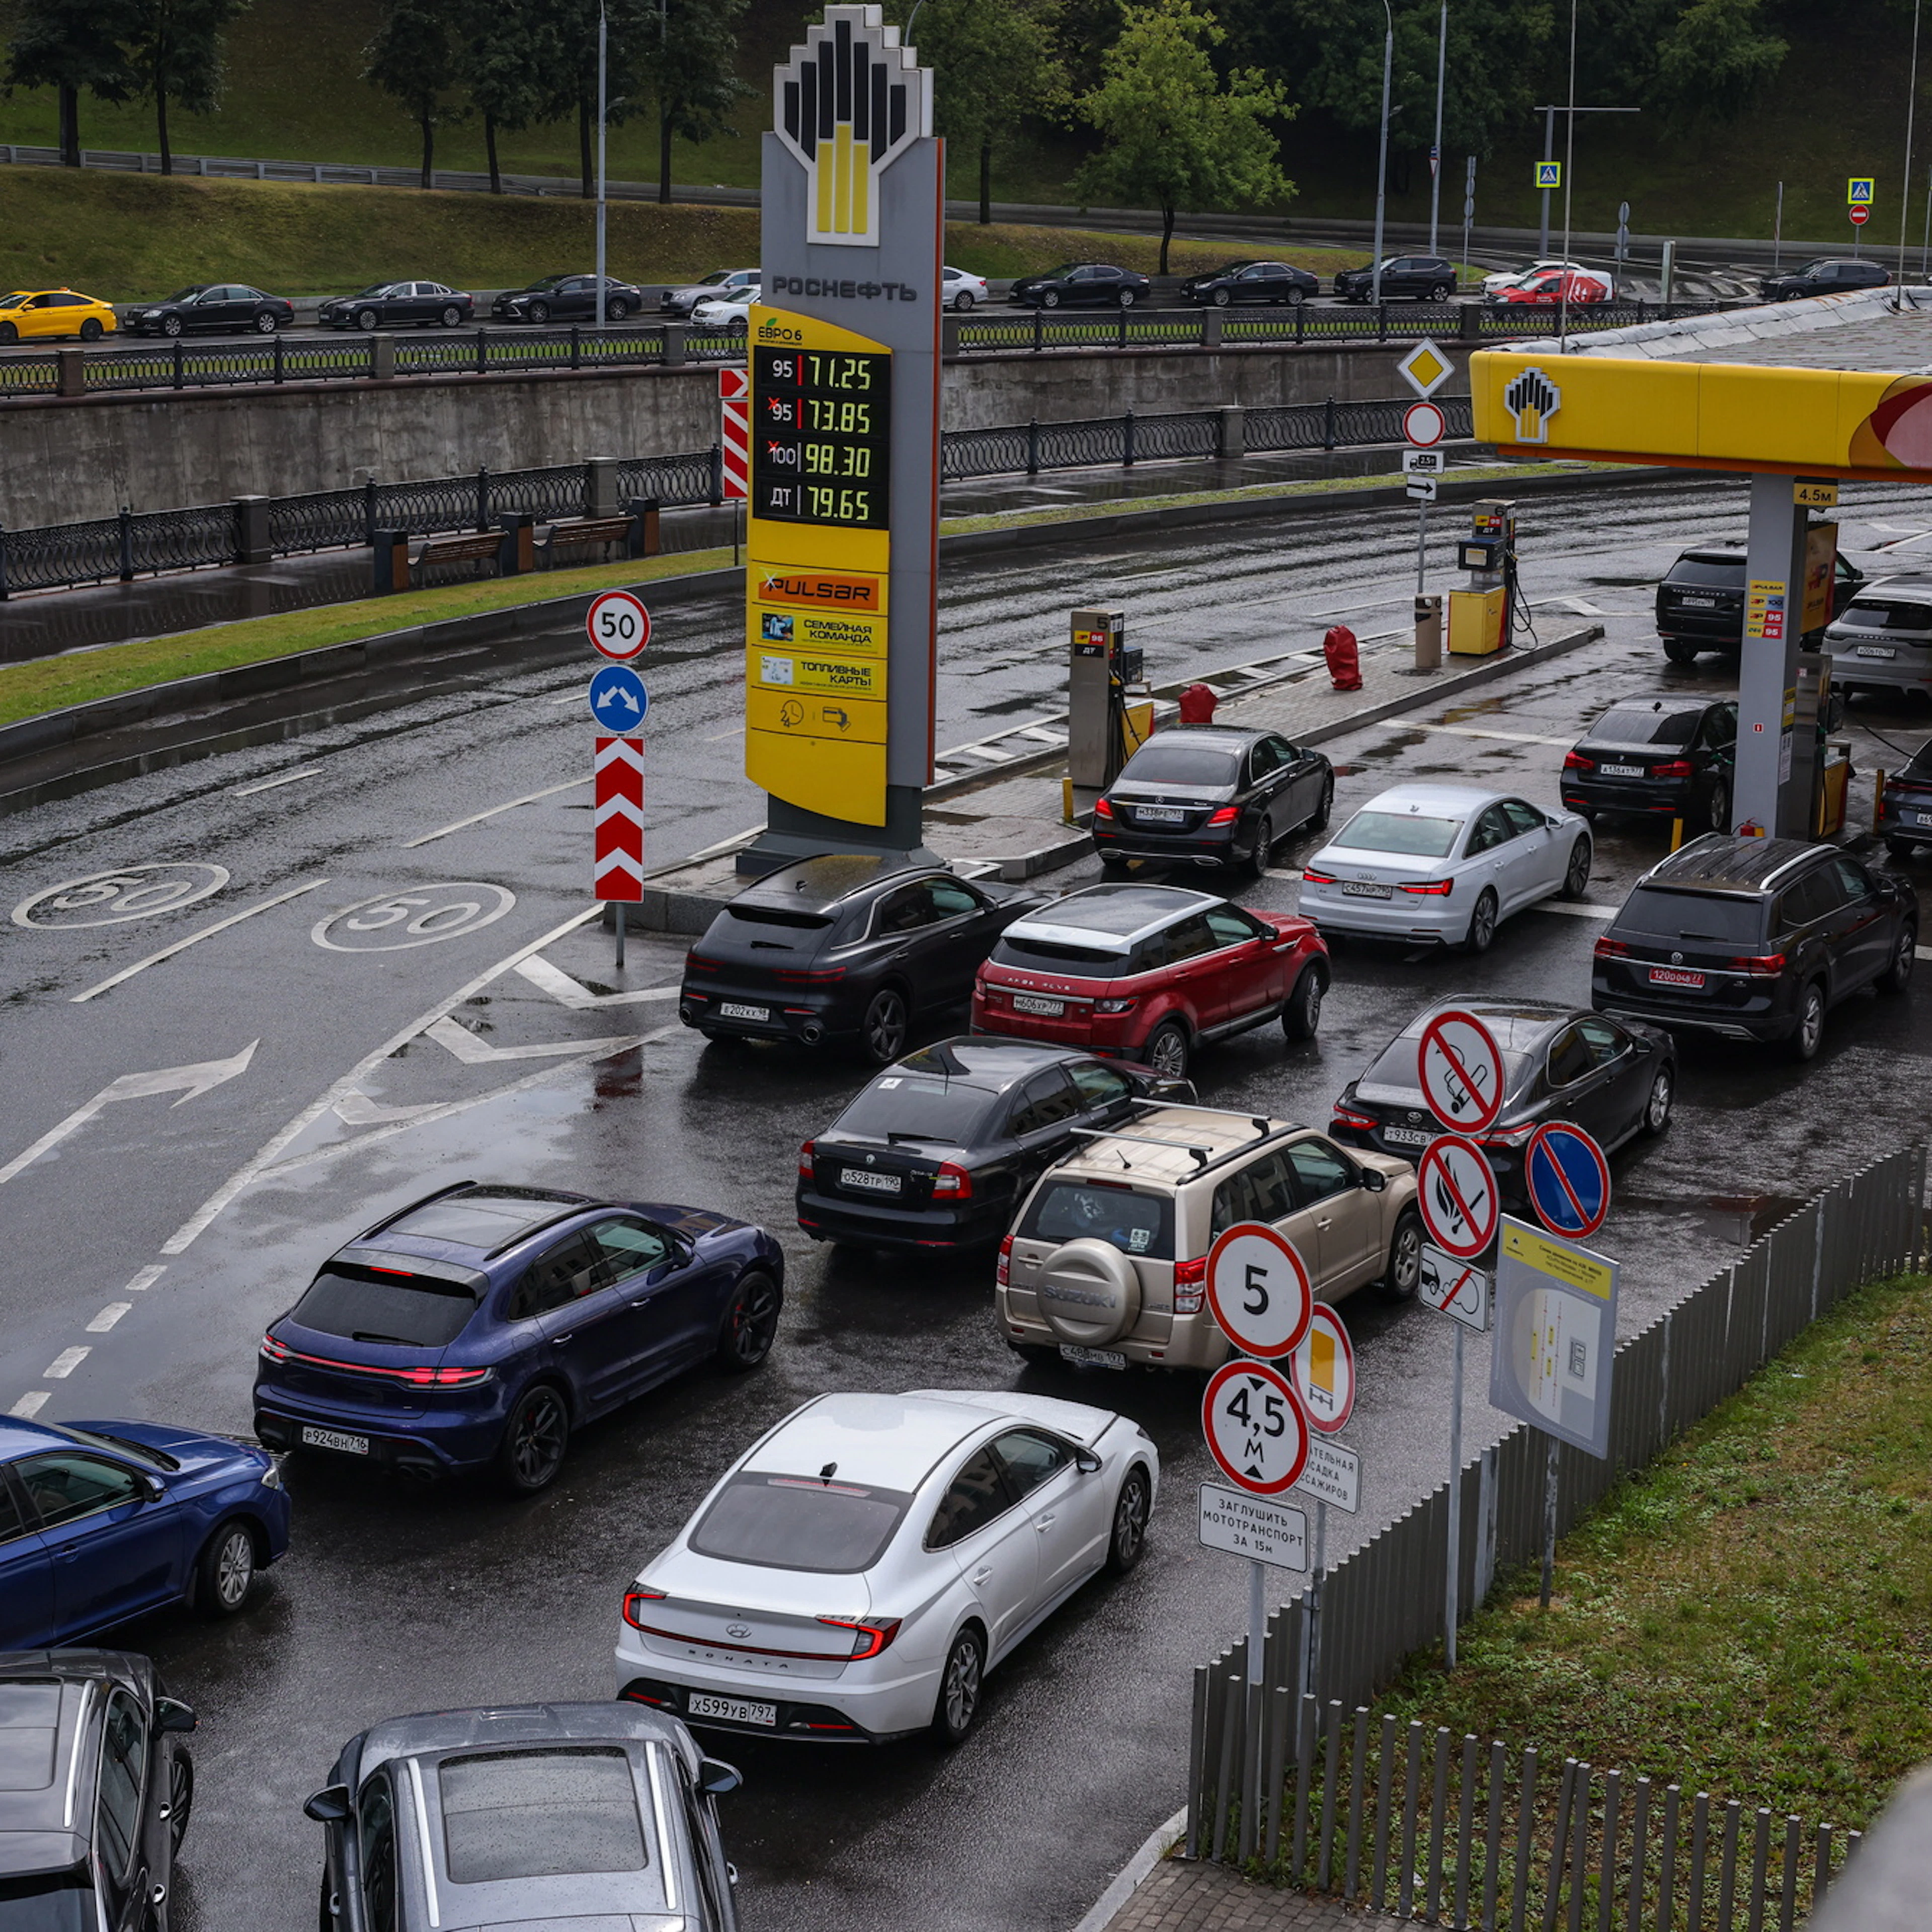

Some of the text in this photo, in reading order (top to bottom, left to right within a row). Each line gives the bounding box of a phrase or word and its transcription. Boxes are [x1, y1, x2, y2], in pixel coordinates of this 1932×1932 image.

[772, 276, 917, 301] РОСНЕФТЬ
[759, 327, 802, 340] ЕВРО 6
[773, 356, 871, 389] 95 71.25
[773, 399, 870, 434] 95 73.85
[771, 443, 870, 477] 100 98.30
[770, 485, 869, 520] ДТ 79.65
[1495, 507, 1504, 516] 6
[769, 579, 870, 600] PULSAR
[602, 612, 635, 639] 50
[804, 620, 872, 634] СЕМЕЙНАЯ
[1098, 617, 1107, 629] 5
[810, 630, 872, 643] КОМАНДА
[801, 662, 871, 676] ТОПЛИВНЫЕ
[830, 676, 871, 686] КАРТЫ
[52, 876, 193, 911] 50
[347, 898, 481, 934] 50
[844, 1171, 881, 1186] О528ТР
[1044, 1284, 1116, 1309] SUZUKI
[1244, 1264, 1269, 1316] 5
[1226, 1387, 1285, 1437] 4,5
[306, 1430, 366, 1448] Р924ВН 716
[1308, 1461, 1339, 1481] САДКА
[1219, 1499, 1287, 1526] ЗАГЛУШИТЬ
[1203, 1511, 1303, 1546] МОТОТРАНСПОРТ
[1233, 1534, 1273, 1554] ЗА 15м
[688, 1649, 788, 1668] SONATA
[694, 1699, 771, 1719] Х599УВ 797
